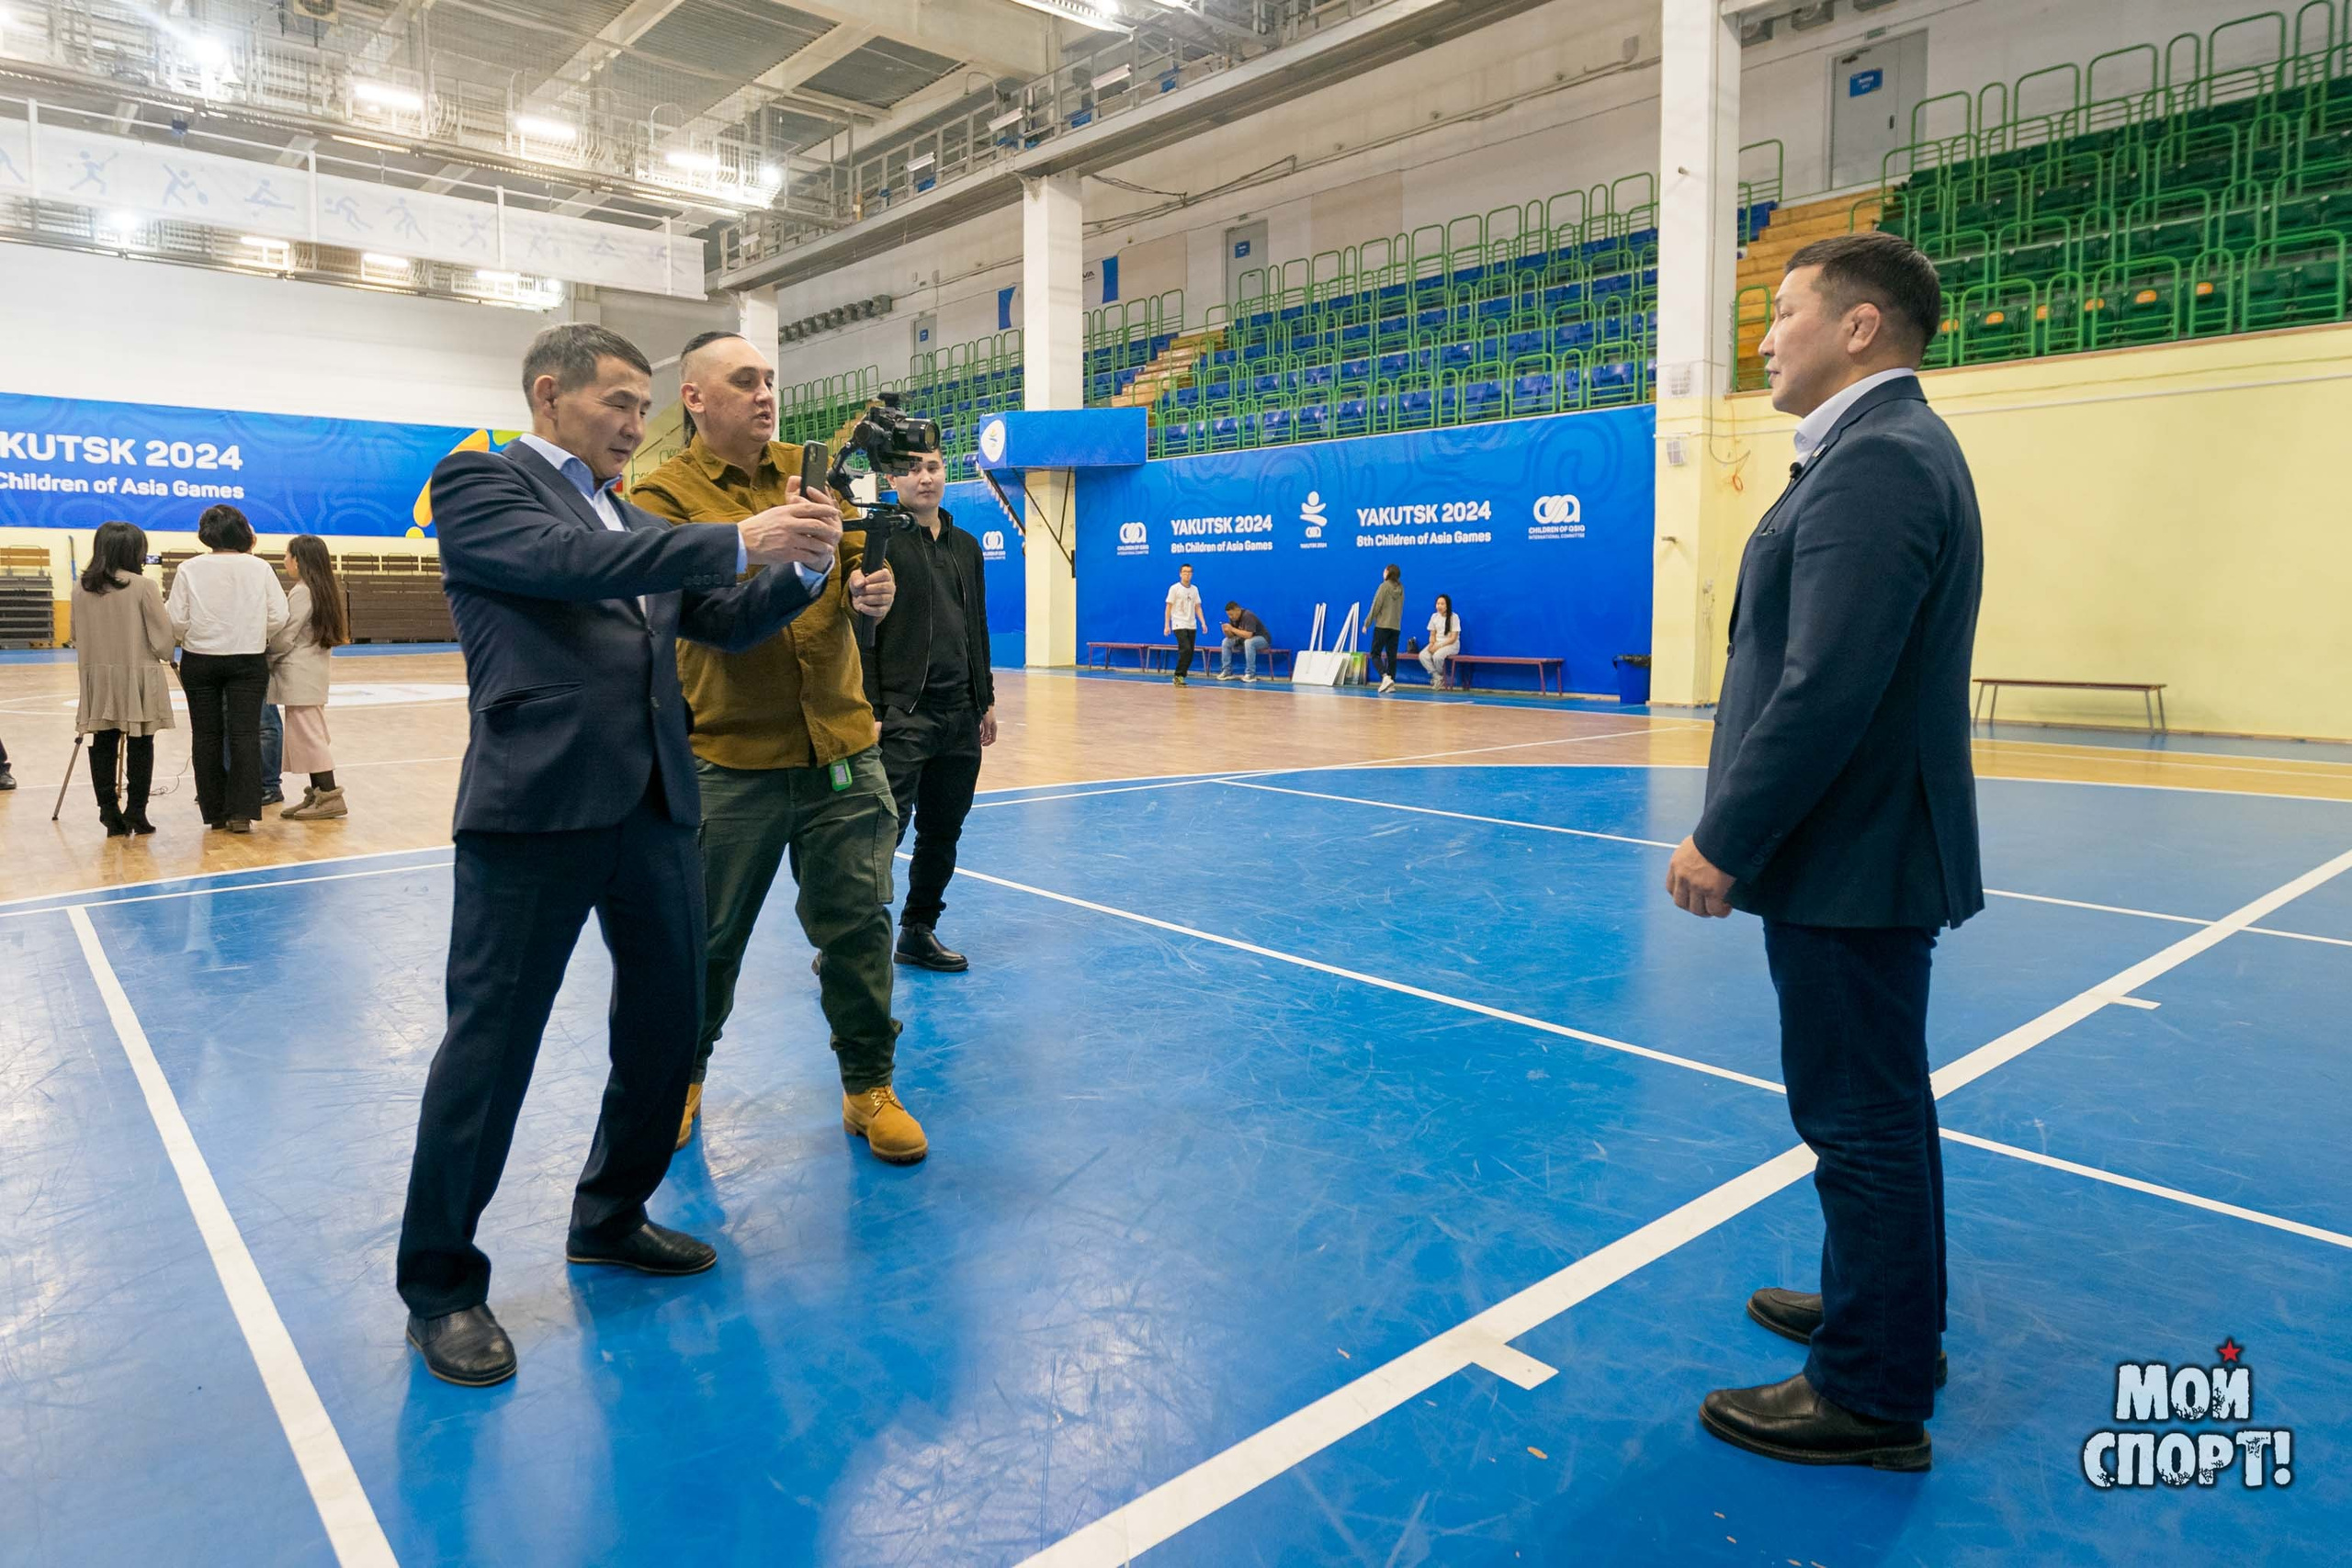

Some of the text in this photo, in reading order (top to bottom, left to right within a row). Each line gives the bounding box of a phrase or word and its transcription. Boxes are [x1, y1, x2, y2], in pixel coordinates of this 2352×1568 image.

[145, 440, 243, 470] 2024
[93, 477, 118, 494] of
[120, 478, 168, 496] Asia
[173, 480, 244, 499] Games
[1170, 514, 1273, 536] YAKUTSK 2024
[1356, 501, 1492, 527] YAKUTSK 2024
[1170, 539, 1273, 554] 8th Children of Asia Games
[1356, 531, 1492, 547] 8th Children of Asia Games
